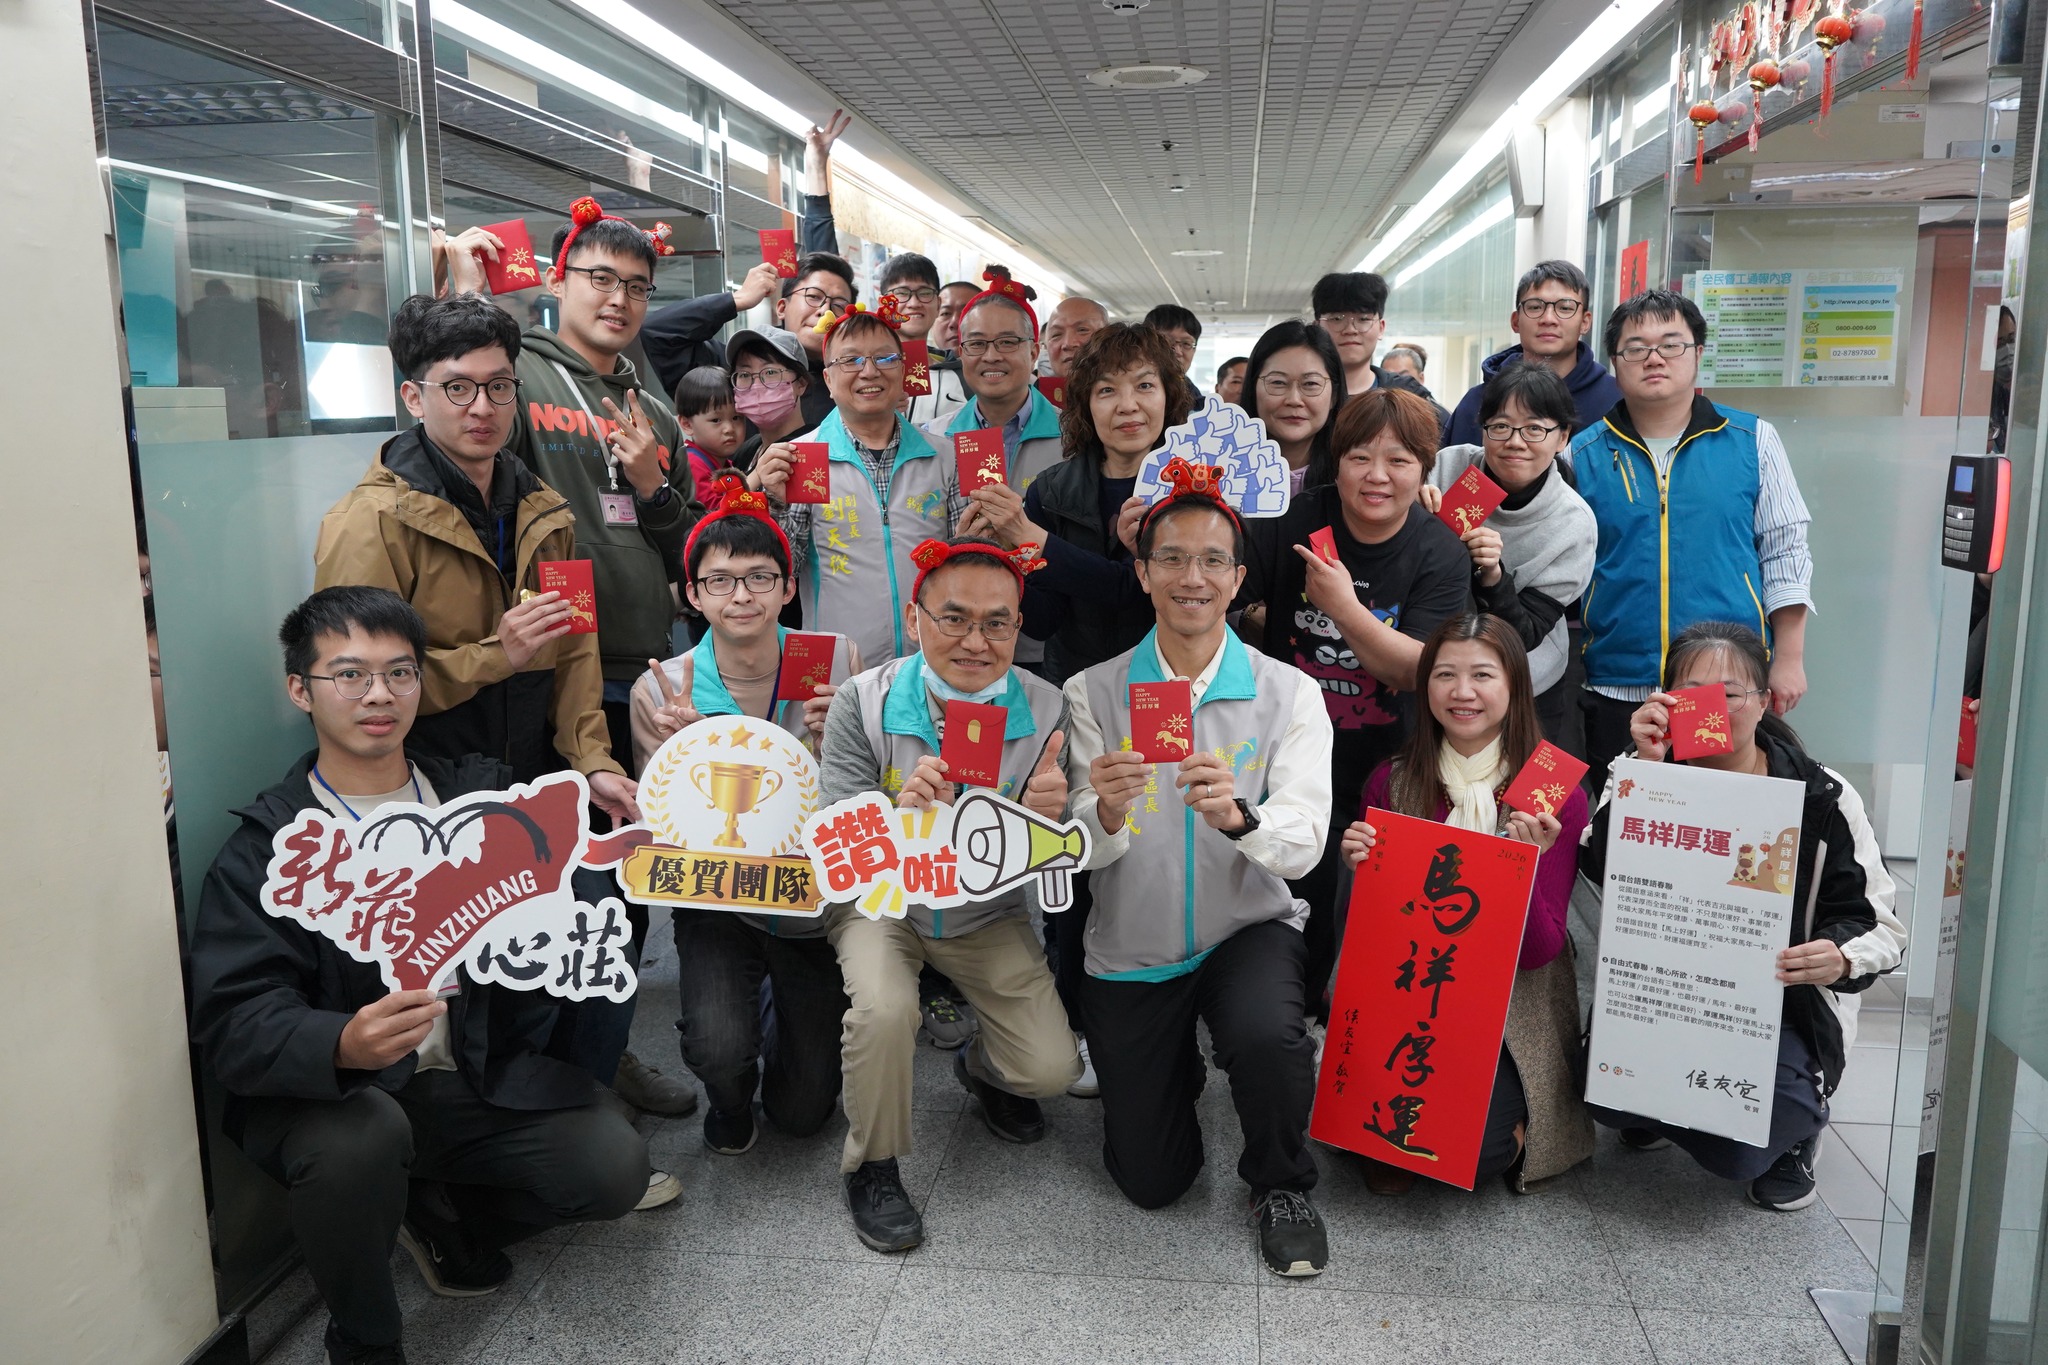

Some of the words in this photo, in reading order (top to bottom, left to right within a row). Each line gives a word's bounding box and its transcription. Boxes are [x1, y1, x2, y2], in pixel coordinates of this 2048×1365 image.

[1823, 298, 1890, 306] http://www.pcc.gov.tw
[1832, 349, 1876, 357] 02-87897800
[1649, 790, 1673, 798] HAPPY
[1619, 816, 1732, 857] 馬祥厚運
[1496, 848, 1526, 863] 2026
[1778, 834, 1794, 886] 馬祥厚運
[646, 854, 811, 904] 優質團隊
[1618, 874, 1673, 890] 國台語雙語春聯
[407, 868, 538, 976] XINZHUANG
[1362, 843, 1481, 1162] 馬祥厚運
[1686, 1069, 1760, 1102] 侯友宜
